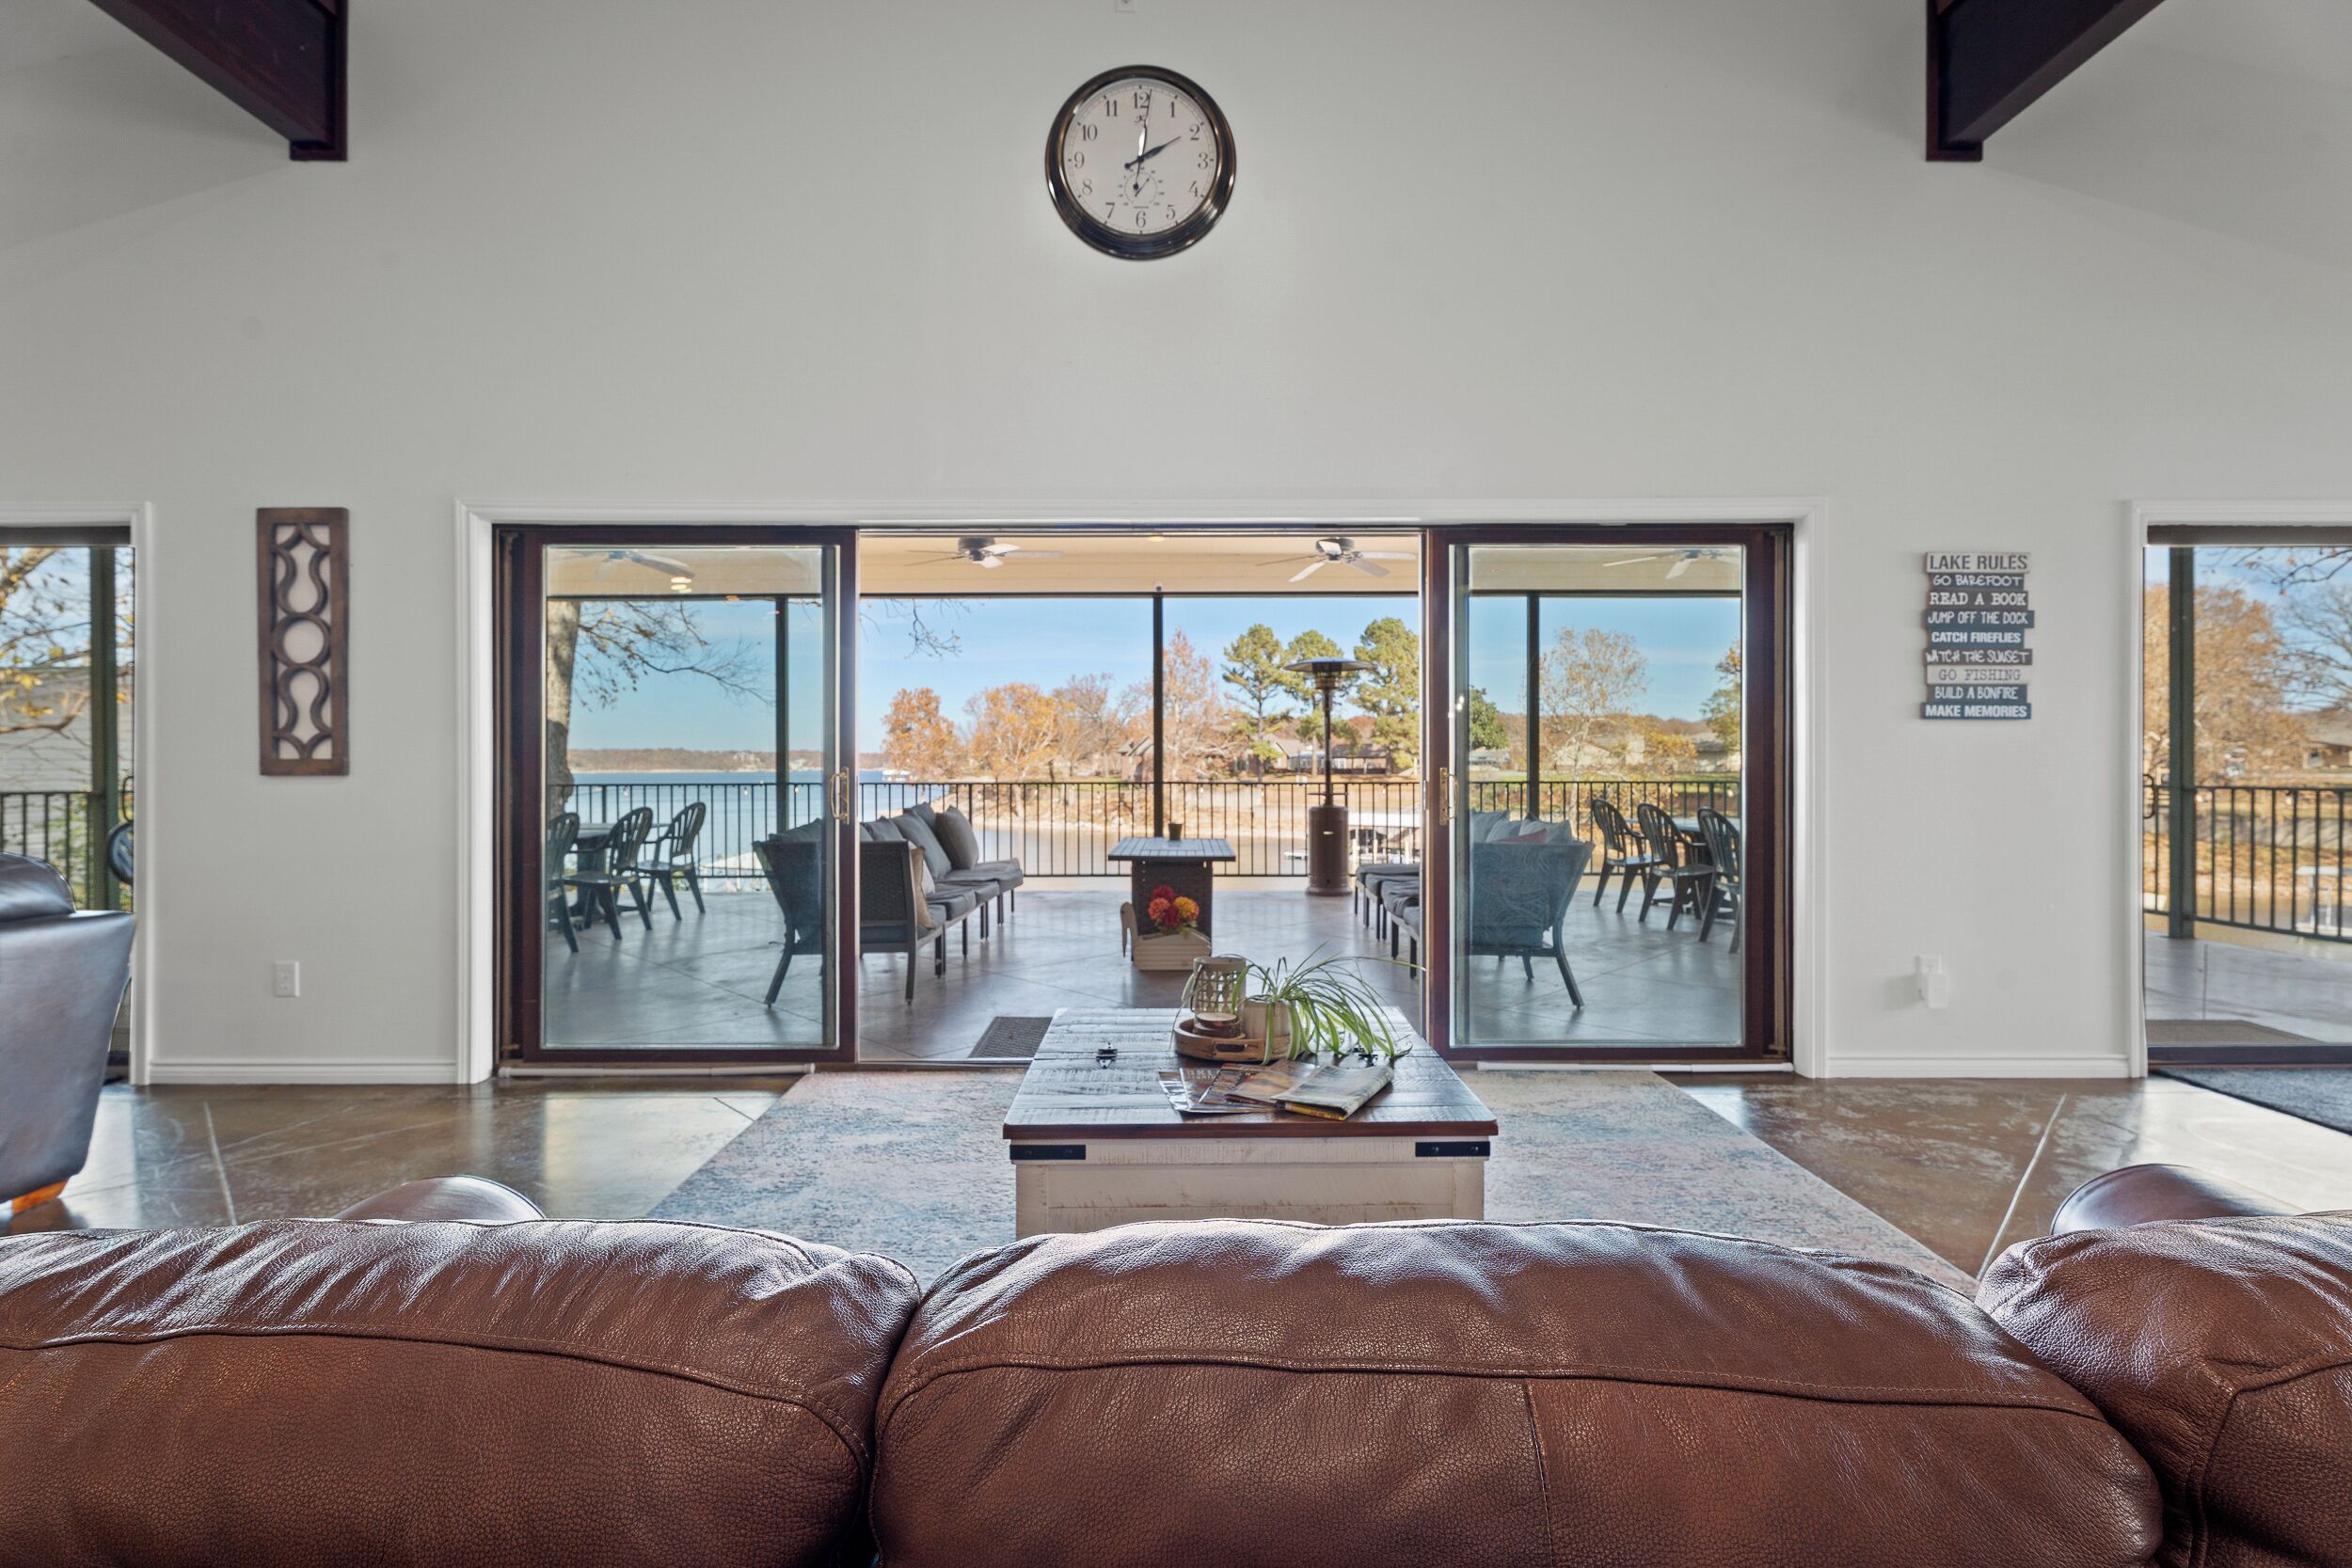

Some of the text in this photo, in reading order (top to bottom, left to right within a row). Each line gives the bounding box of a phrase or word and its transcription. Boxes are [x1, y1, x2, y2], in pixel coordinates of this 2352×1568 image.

[1133, 92, 1150, 109] 12
[1105, 100, 1118, 117] 11
[1169, 101, 1175, 118] 1
[1082, 124, 1098, 141] 10
[1189, 124, 1200, 140] 2
[1073, 152, 1085, 167] 9
[1198, 153, 1208, 169] 3
[1082, 179, 1093, 195] 8
[1189, 181, 1198, 198] 4
[1105, 202, 1115, 218] 7
[1167, 205, 1175, 219] 5
[1136, 213, 1146, 228] 6
[1930, 555, 2027, 569] LAKE RULES
[1933, 576, 2022, 586] GO BAREFOOT
[1930, 593, 2026, 606] READ A BOOK
[1928, 611, 2028, 624] JUMP OFF THE DOCK
[1931, 632, 2021, 642] CATCH FIREFLIES
[1926, 651, 2029, 663] WATCH THE SUNSET
[1938, 669, 2021, 681] GO FISHING
[1934, 688, 2019, 699] BUILD A BONFIRE
[1926, 705, 2027, 717] MAKE MEMORIES
